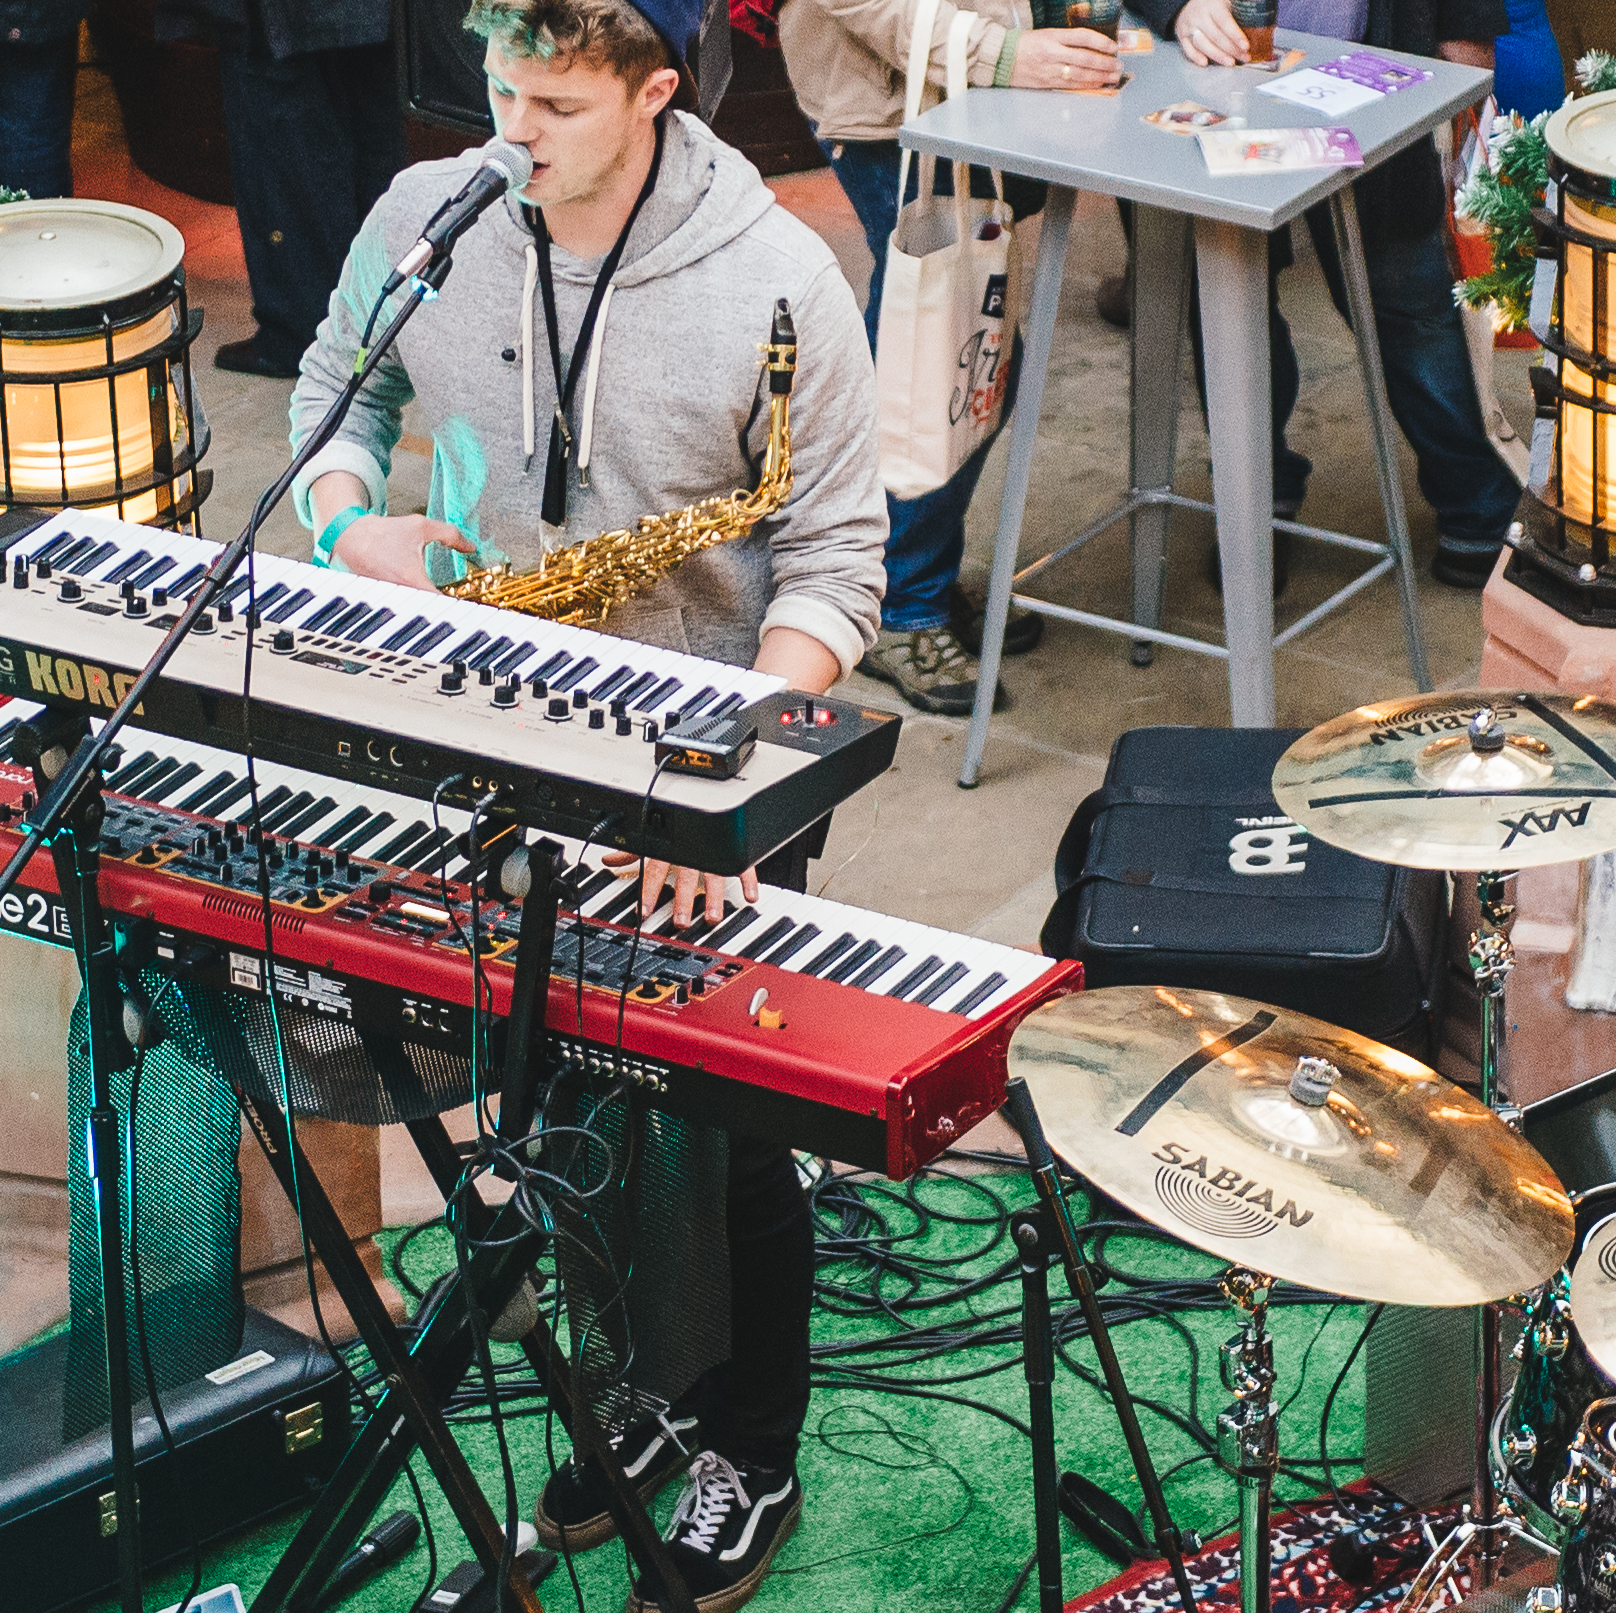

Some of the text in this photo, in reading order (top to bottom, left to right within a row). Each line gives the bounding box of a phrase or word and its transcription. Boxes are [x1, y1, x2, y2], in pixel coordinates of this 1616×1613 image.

[1497, 801, 1592, 851] AAX
[26, 893, 50, 933] 2
[1149, 1141, 1315, 1230] SABIAN
